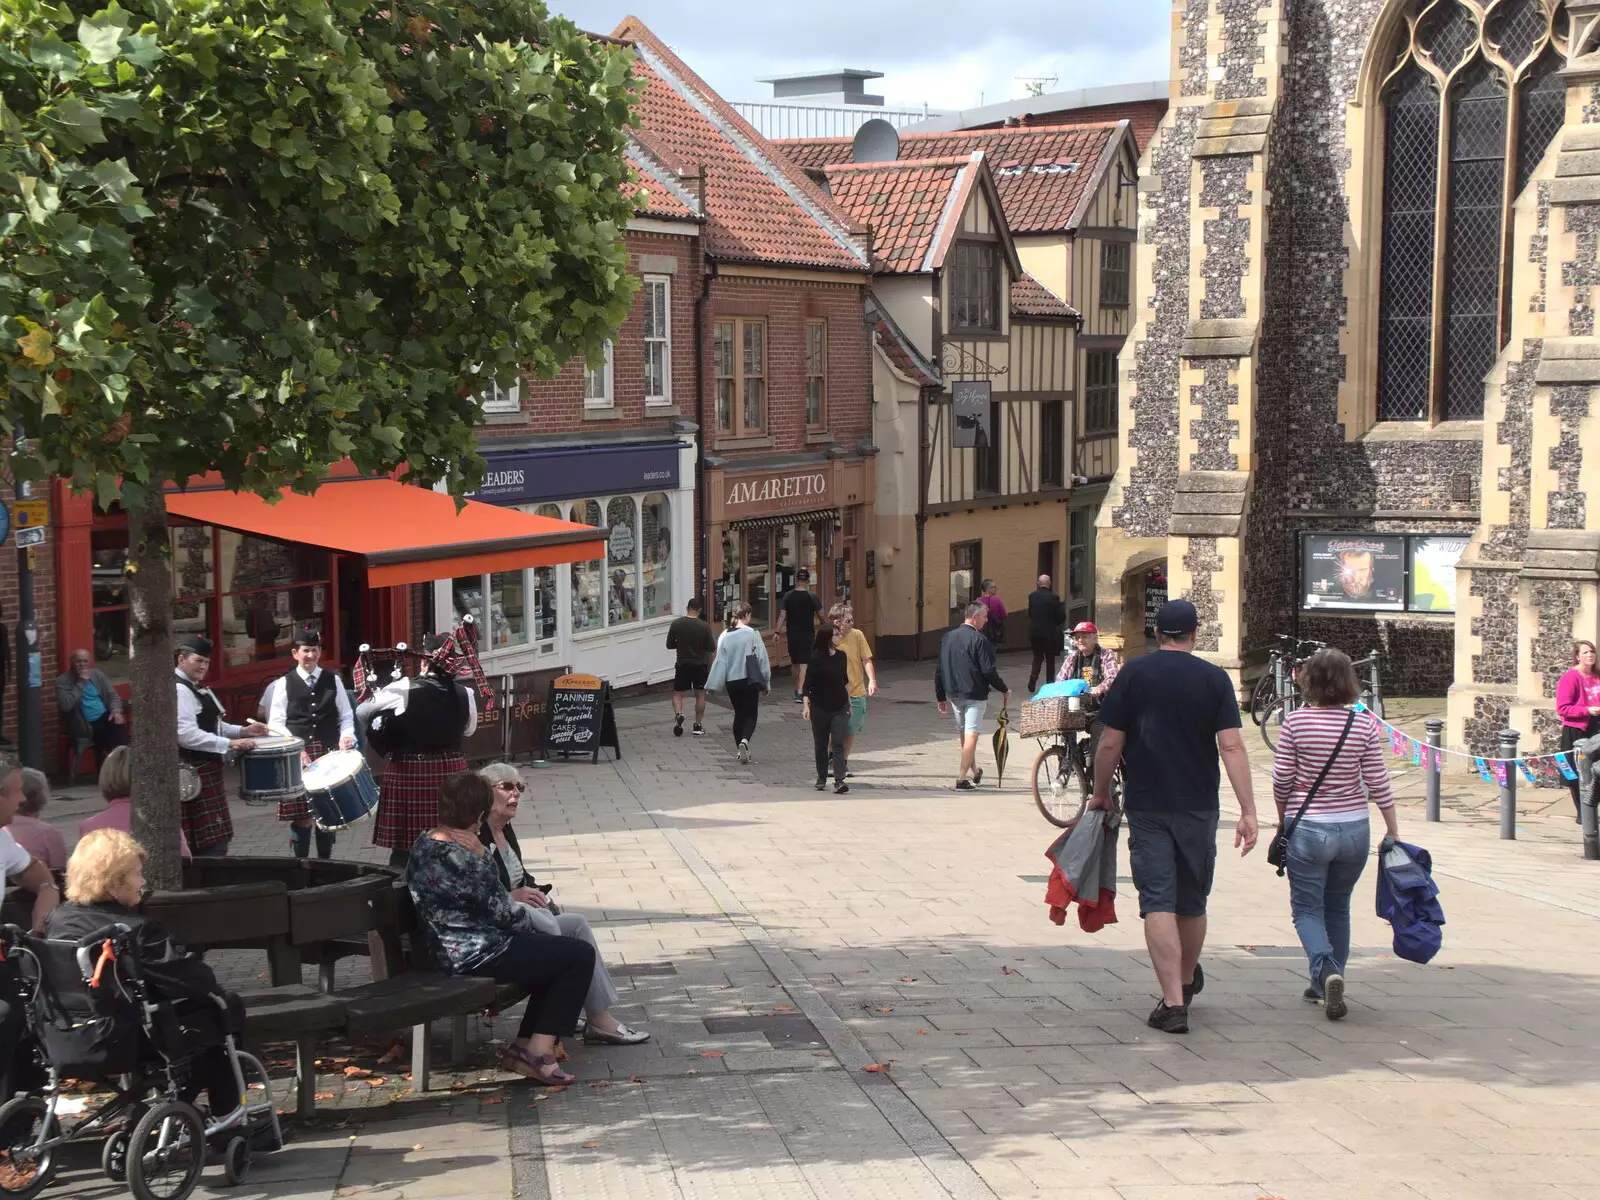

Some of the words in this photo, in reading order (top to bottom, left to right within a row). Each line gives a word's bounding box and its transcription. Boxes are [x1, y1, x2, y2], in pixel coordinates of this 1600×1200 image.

[481, 470, 525, 487] LEADERS
[644, 468, 671, 480] leaders.co.uk
[726, 474, 826, 504] AMARETTO
[1327, 539, 1354, 552] John
[555, 693, 595, 703] PANINIS
[564, 711, 593, 724] specials
[551, 724, 577, 732] CAKES
